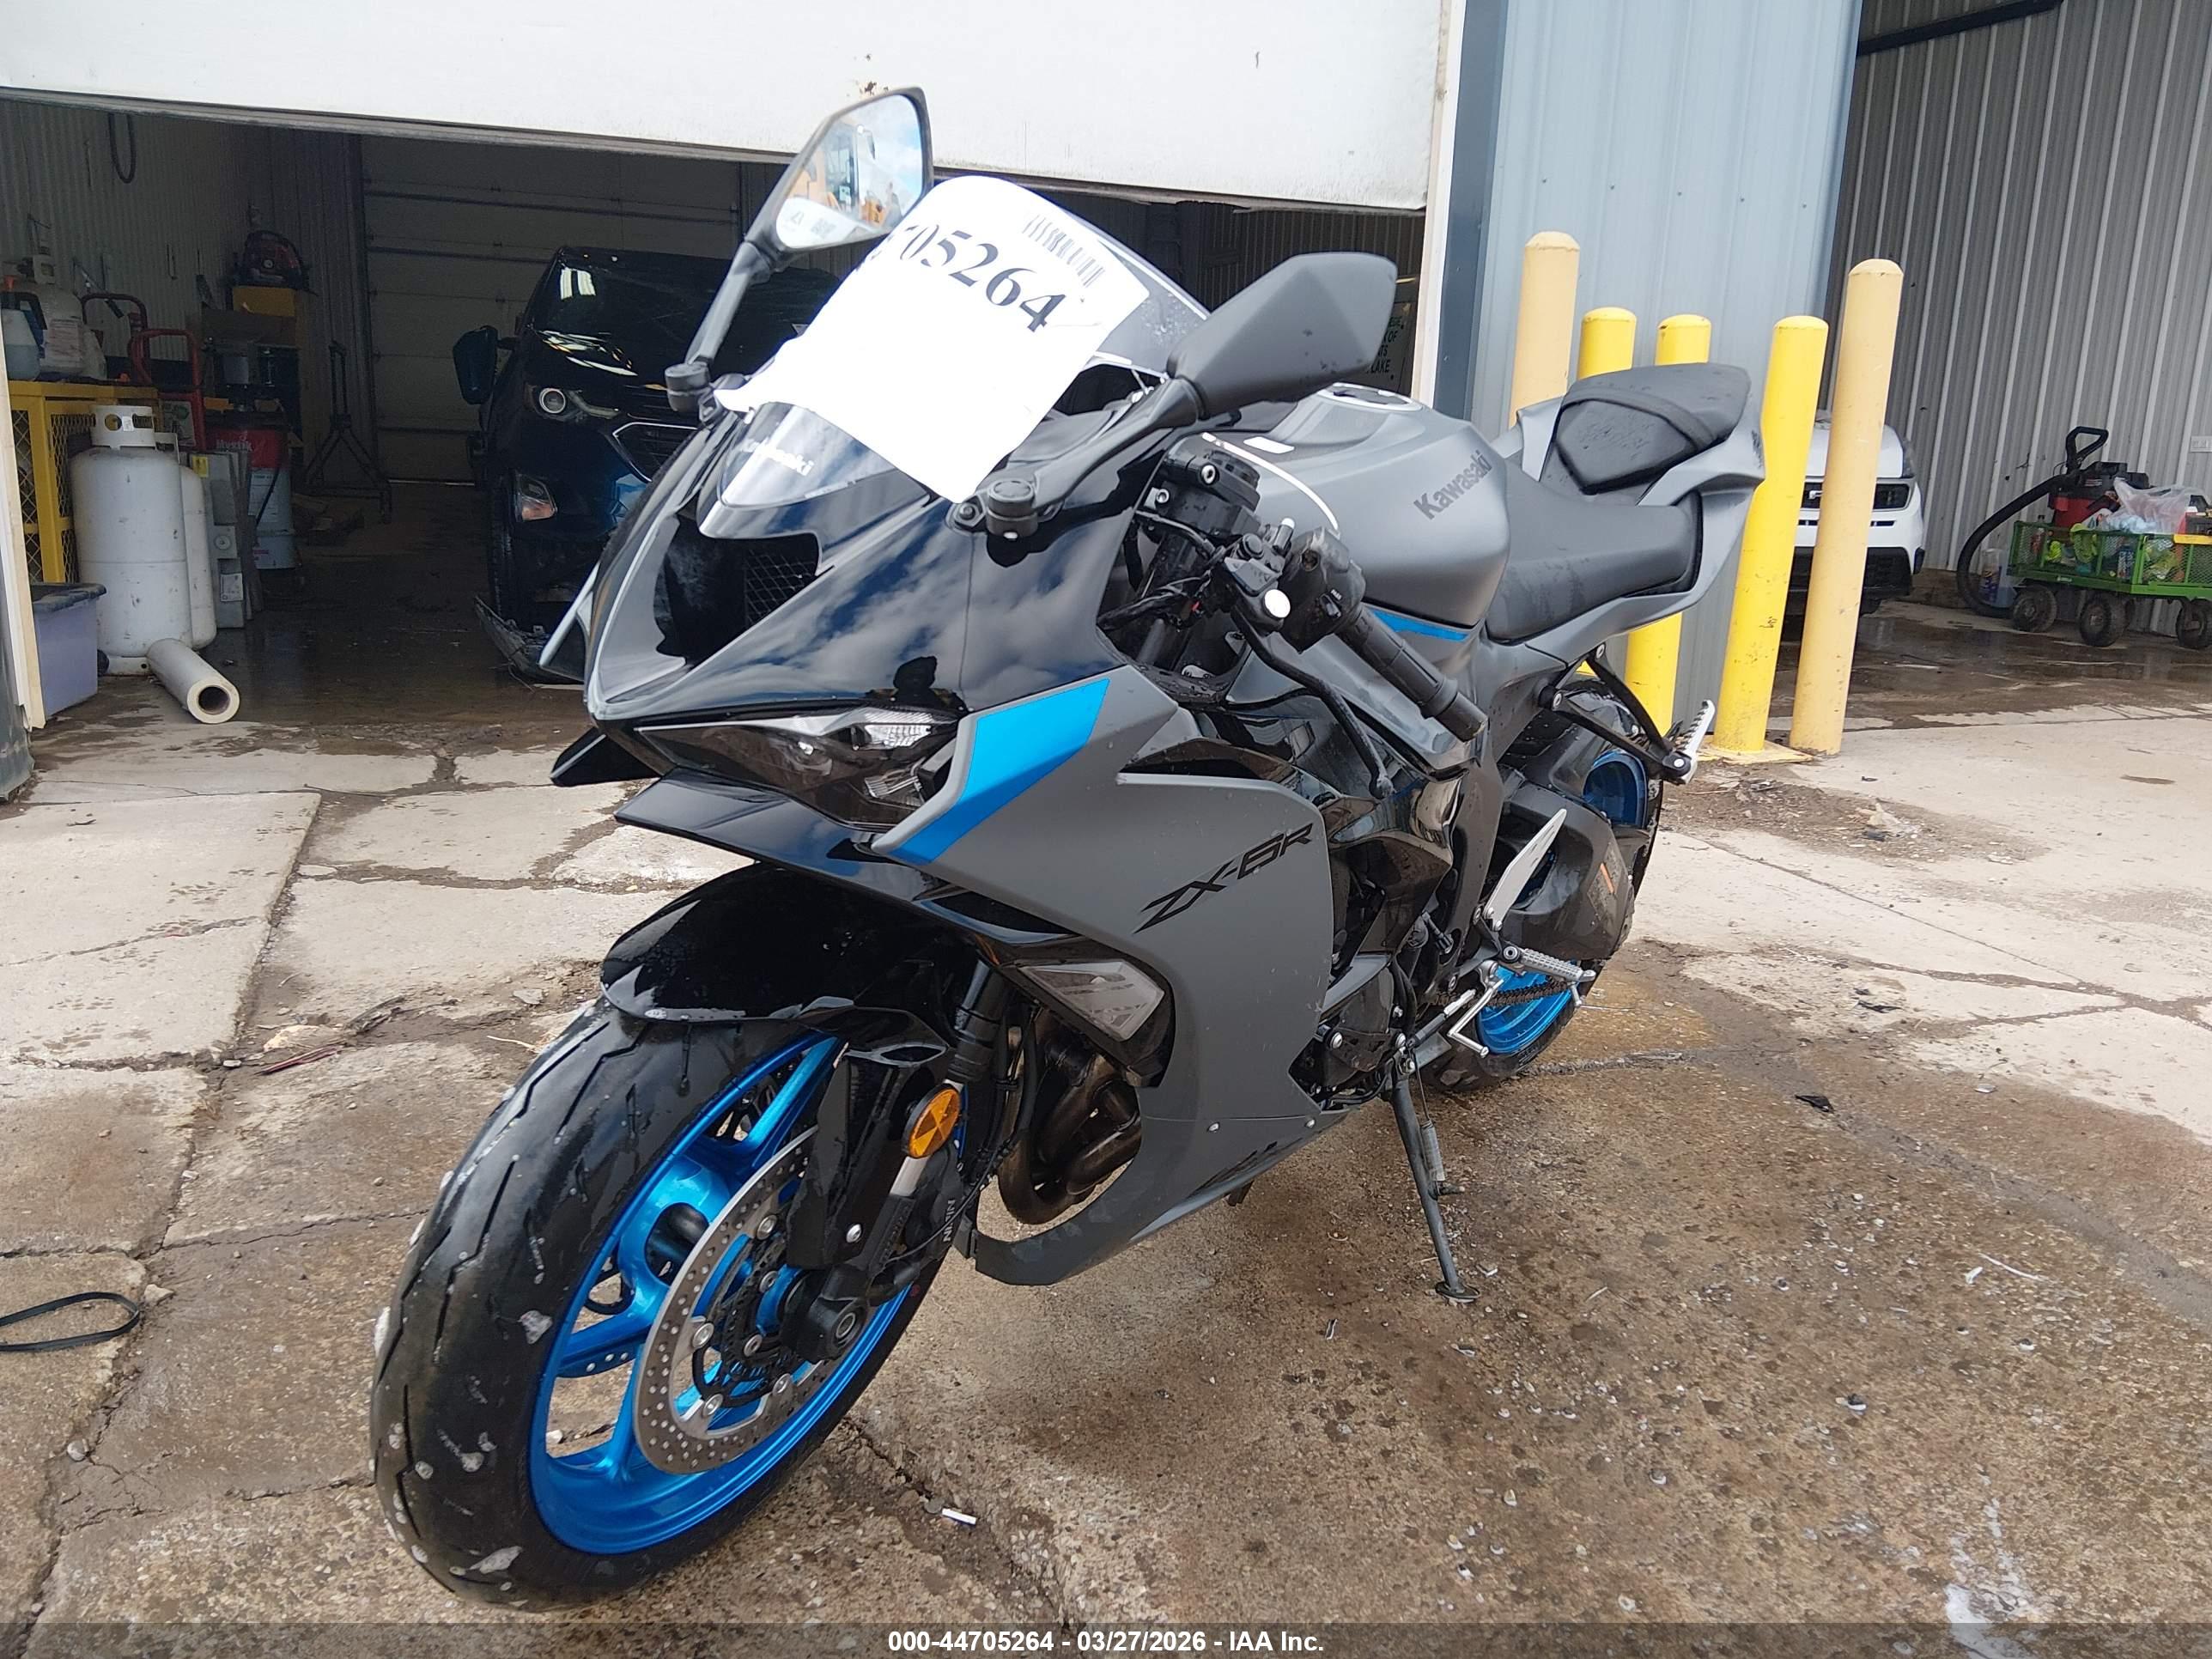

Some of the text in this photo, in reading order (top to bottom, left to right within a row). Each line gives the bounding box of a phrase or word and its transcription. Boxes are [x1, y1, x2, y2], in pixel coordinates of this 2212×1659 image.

[869, 224, 1066, 332] 05264
[1413, 449, 1492, 520] Kawasaki
[1133, 823, 1313, 934] ZX-6R
[943, 1199, 956, 1243] NISIN
